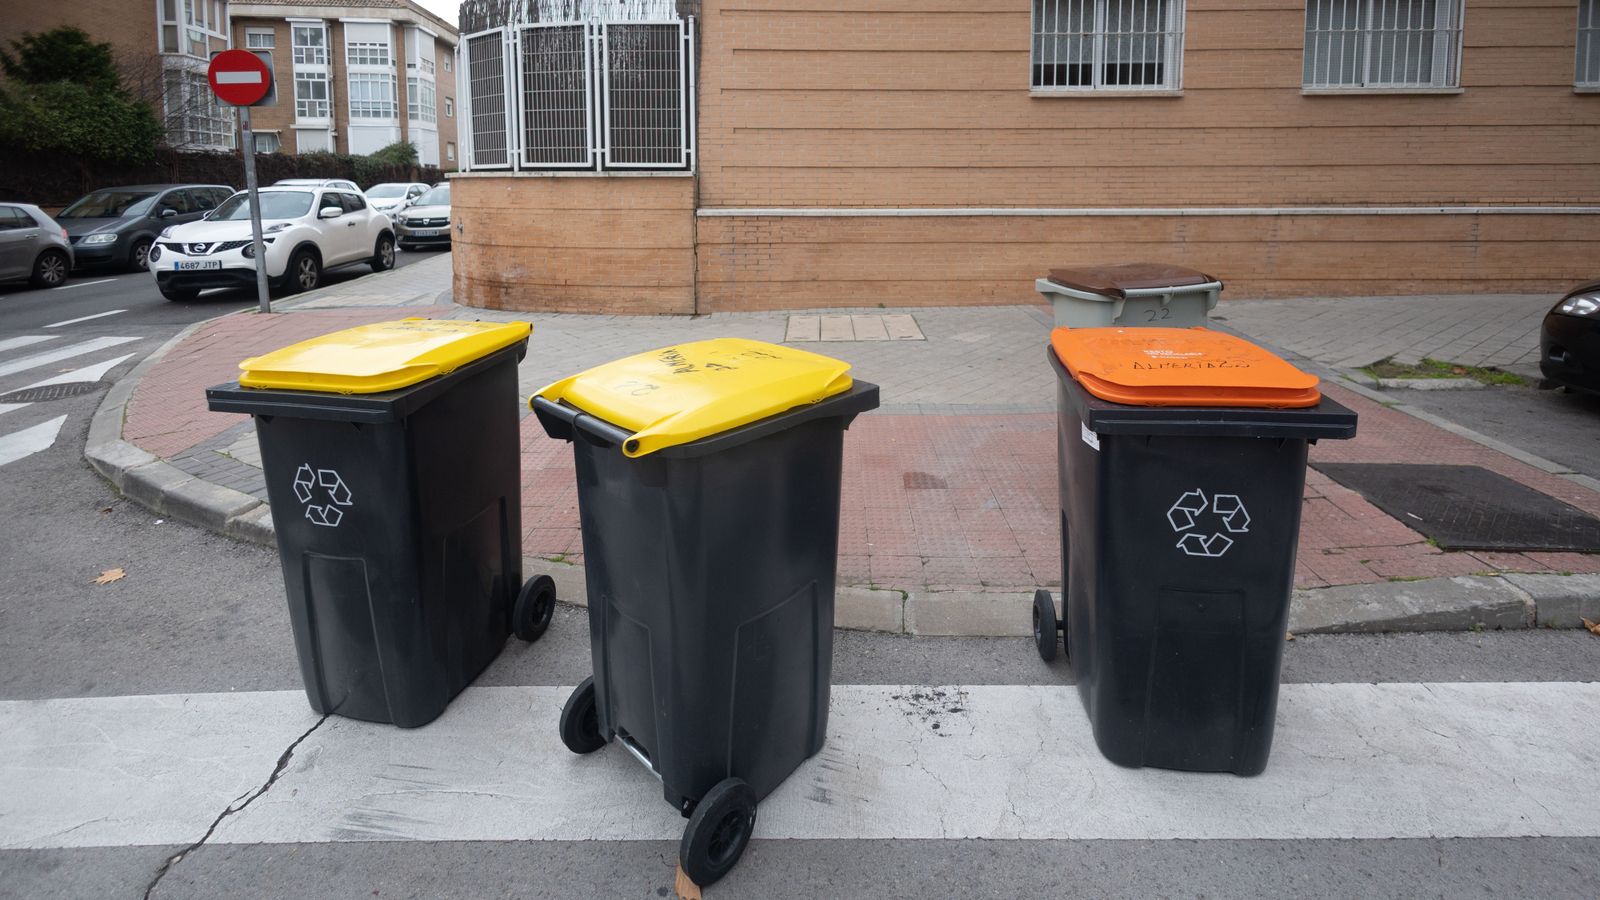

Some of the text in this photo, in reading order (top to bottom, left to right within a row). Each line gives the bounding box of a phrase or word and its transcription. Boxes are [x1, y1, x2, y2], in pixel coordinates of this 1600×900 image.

[180, 261, 218, 270] 4687 JTP
[1143, 307, 1174, 322] 22
